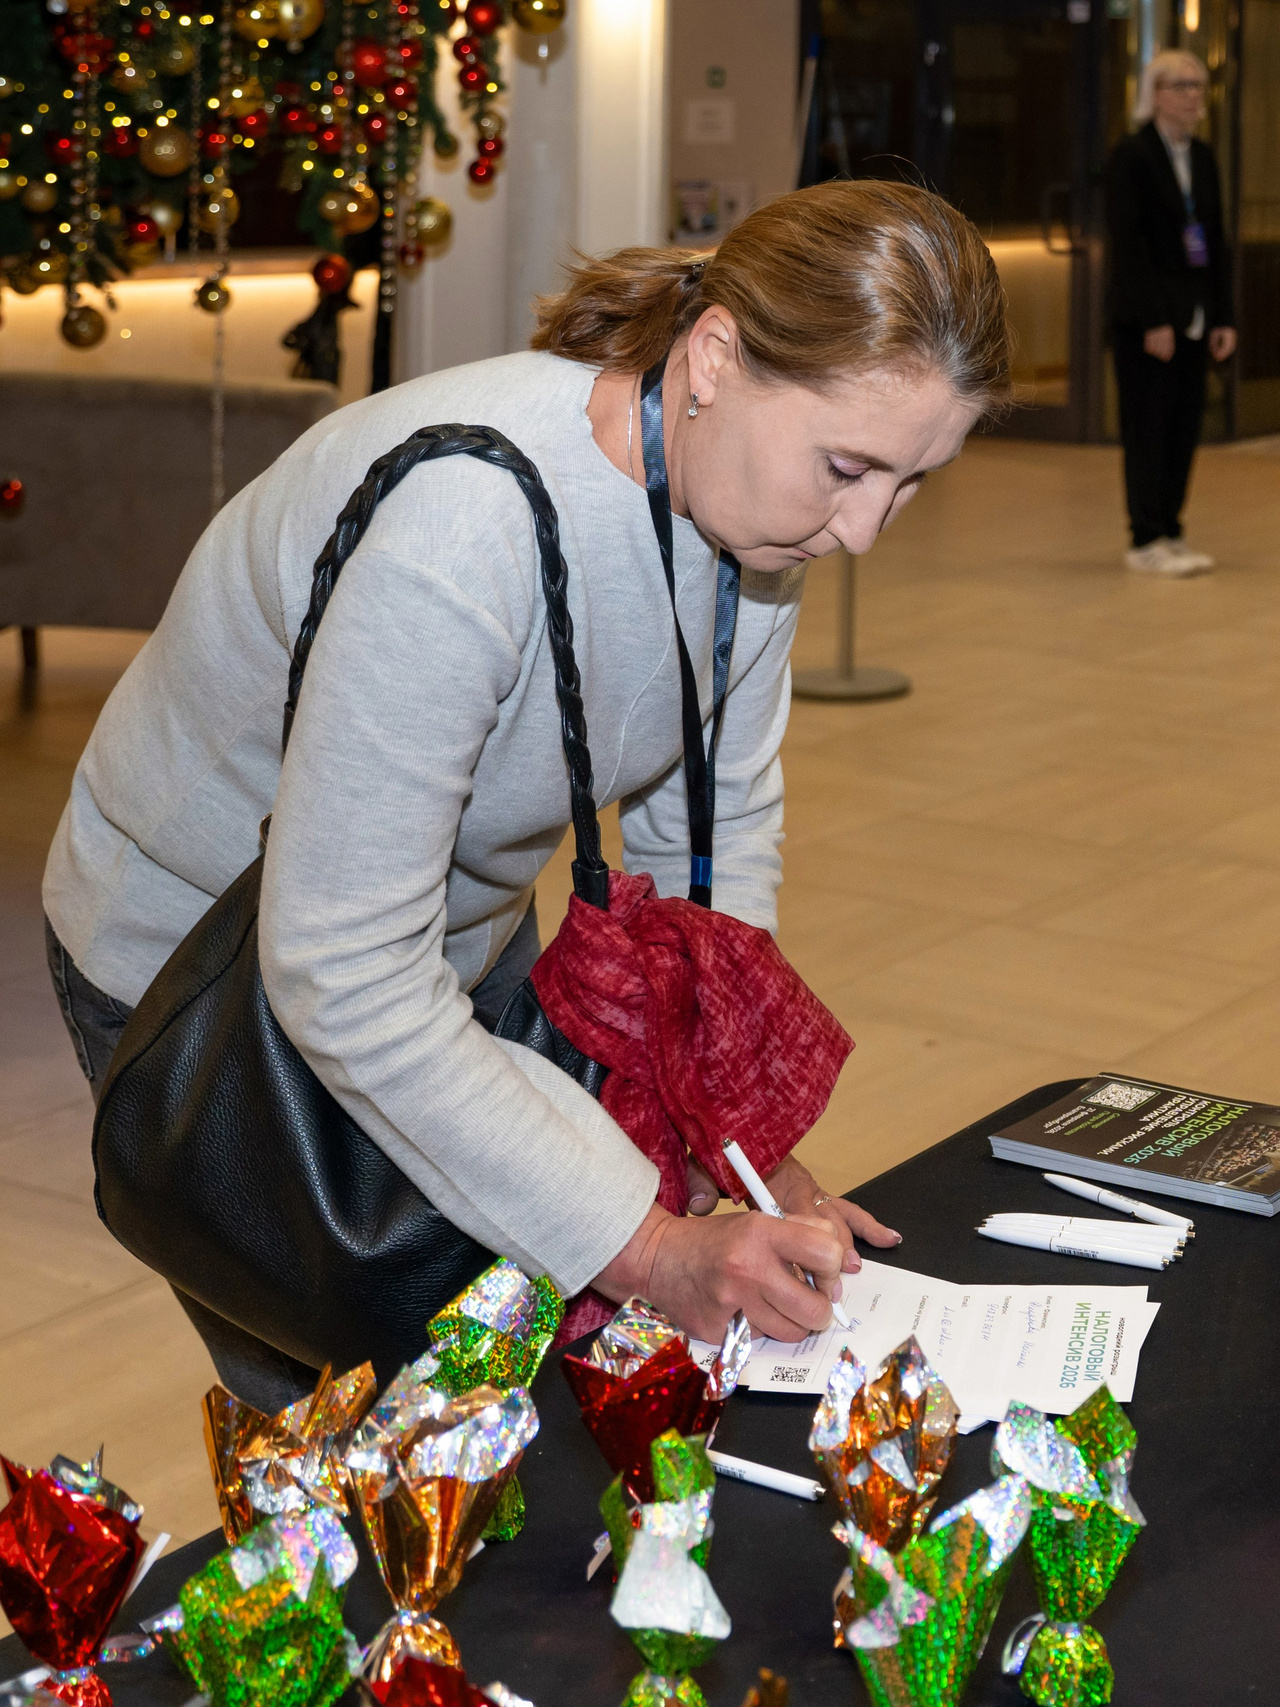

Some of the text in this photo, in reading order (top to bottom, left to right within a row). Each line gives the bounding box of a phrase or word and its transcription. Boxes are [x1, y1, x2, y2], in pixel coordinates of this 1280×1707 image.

[1139, 1094, 1187, 1122] ПРАКТИКА
[1141, 1097, 1200, 1132] УПРАВЛЕНИЕ
[1161, 1107, 1249, 1157] НАЛОГОВЫЙ
[1123, 1103, 1230, 1164] ИНТЕНСИВ 2026
[1059, 1302, 1092, 1388] ИНТЕНСИВ 2026
[1083, 1311, 1111, 1381] НАЛОГОВЫЙ
[1116, 1317, 1125, 1348] новогодний
